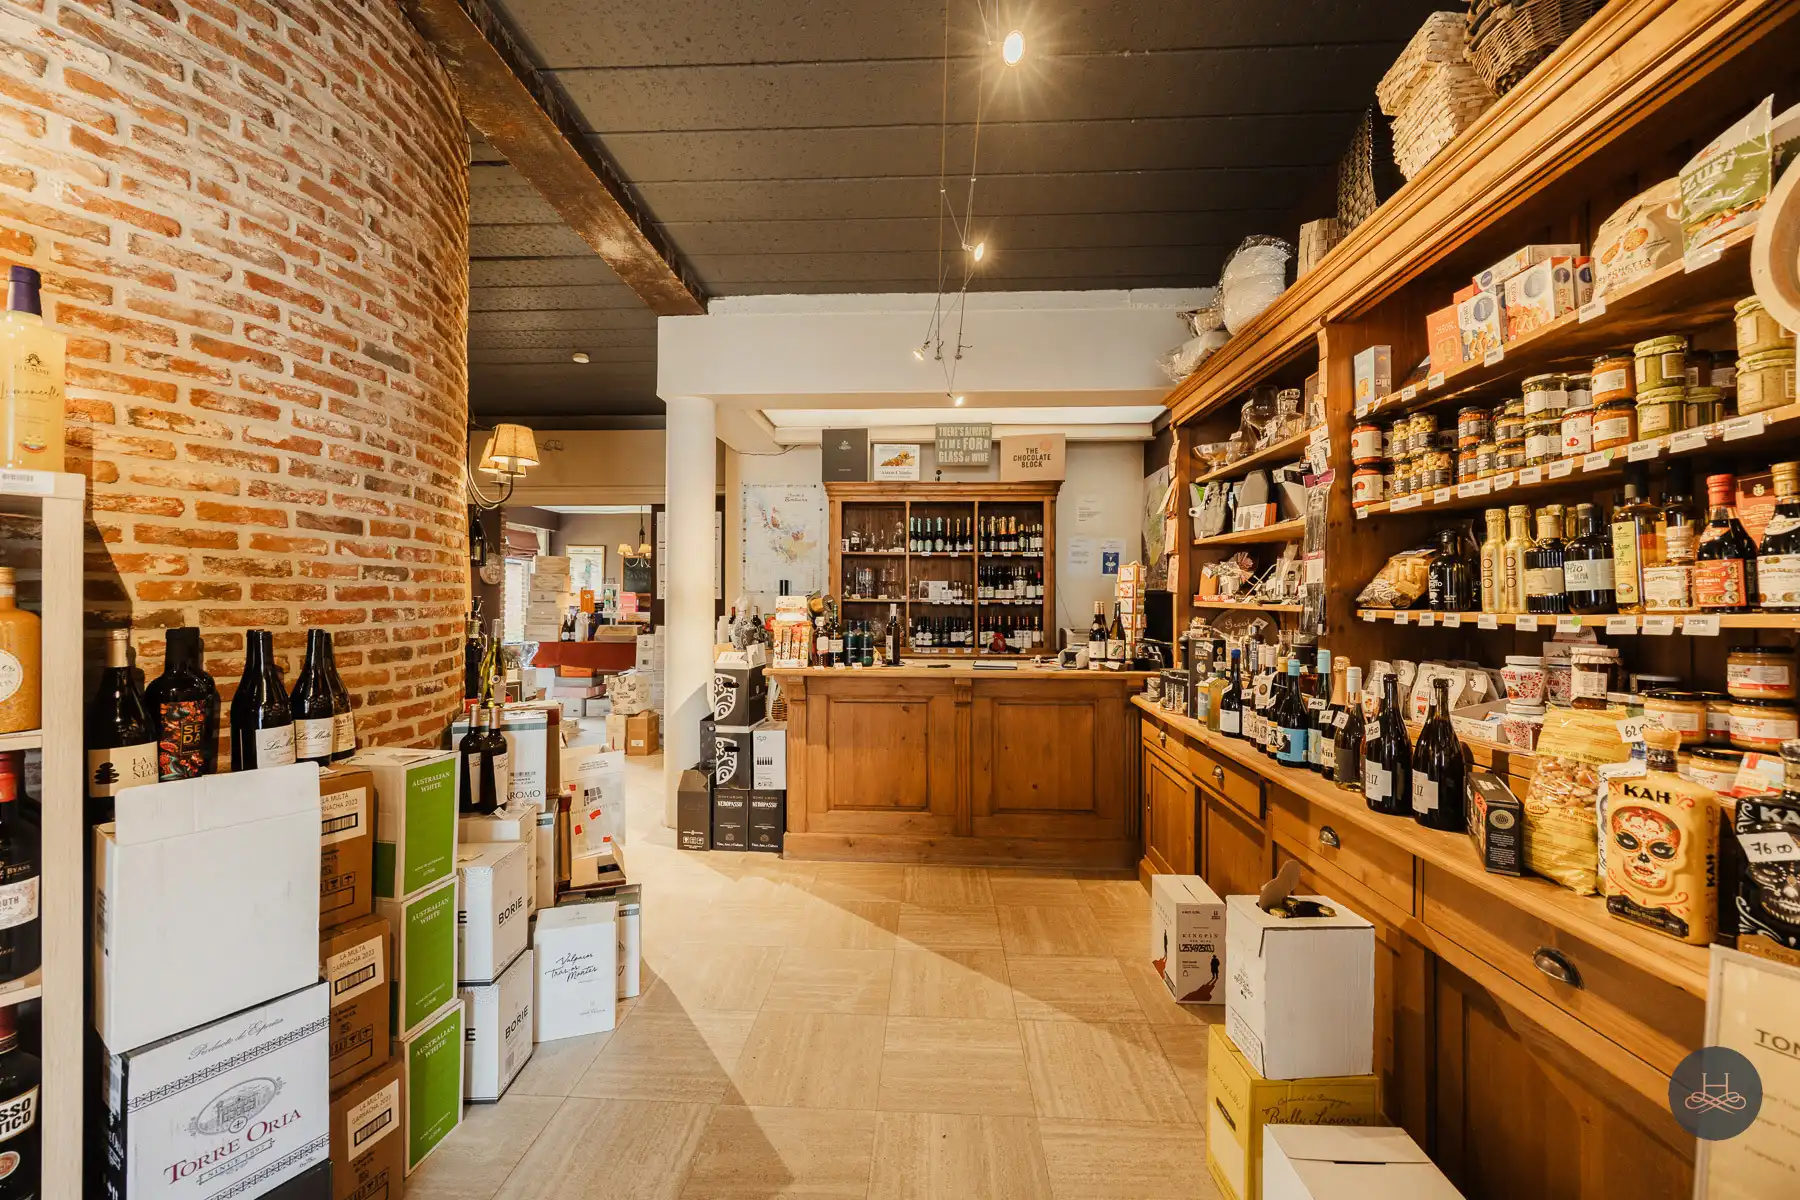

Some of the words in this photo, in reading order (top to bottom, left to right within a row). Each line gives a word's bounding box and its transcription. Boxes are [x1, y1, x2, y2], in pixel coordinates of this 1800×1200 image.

[965, 426, 990, 437] ALWAYS
[939, 439, 960, 449] TIME
[963, 437, 983, 450] FOR
[939, 451, 964, 462] GLASS
[972, 452, 988, 462] WINE
[1483, 558, 1493, 588] OLIO
[1506, 557, 1516, 588] OLIO
[412, 771, 450, 787] AUSTRALIAN
[421, 782, 442, 793] WHITE
[331, 793, 349, 802] MULTA
[1624, 783, 1672, 805] KAH
[1706, 853, 1717, 888] KAH
[412, 898, 449, 922] AUSTRALIAN
[420, 910, 441, 925] WHITE
[498, 896, 523, 925] BORIE
[349, 944, 366, 957] MULTA
[332, 956, 361, 973] GARNACHA
[505, 1005, 529, 1040] BORIE
[415, 1023, 456, 1058] AUSTRALIAN
[424, 1038, 447, 1058] WHITE
[367, 1091, 384, 1107] MULTA
[352, 1102, 380, 1125] GARNACHA
[163, 1138, 241, 1185] TORRE
[246, 1109, 302, 1142] ORIA
